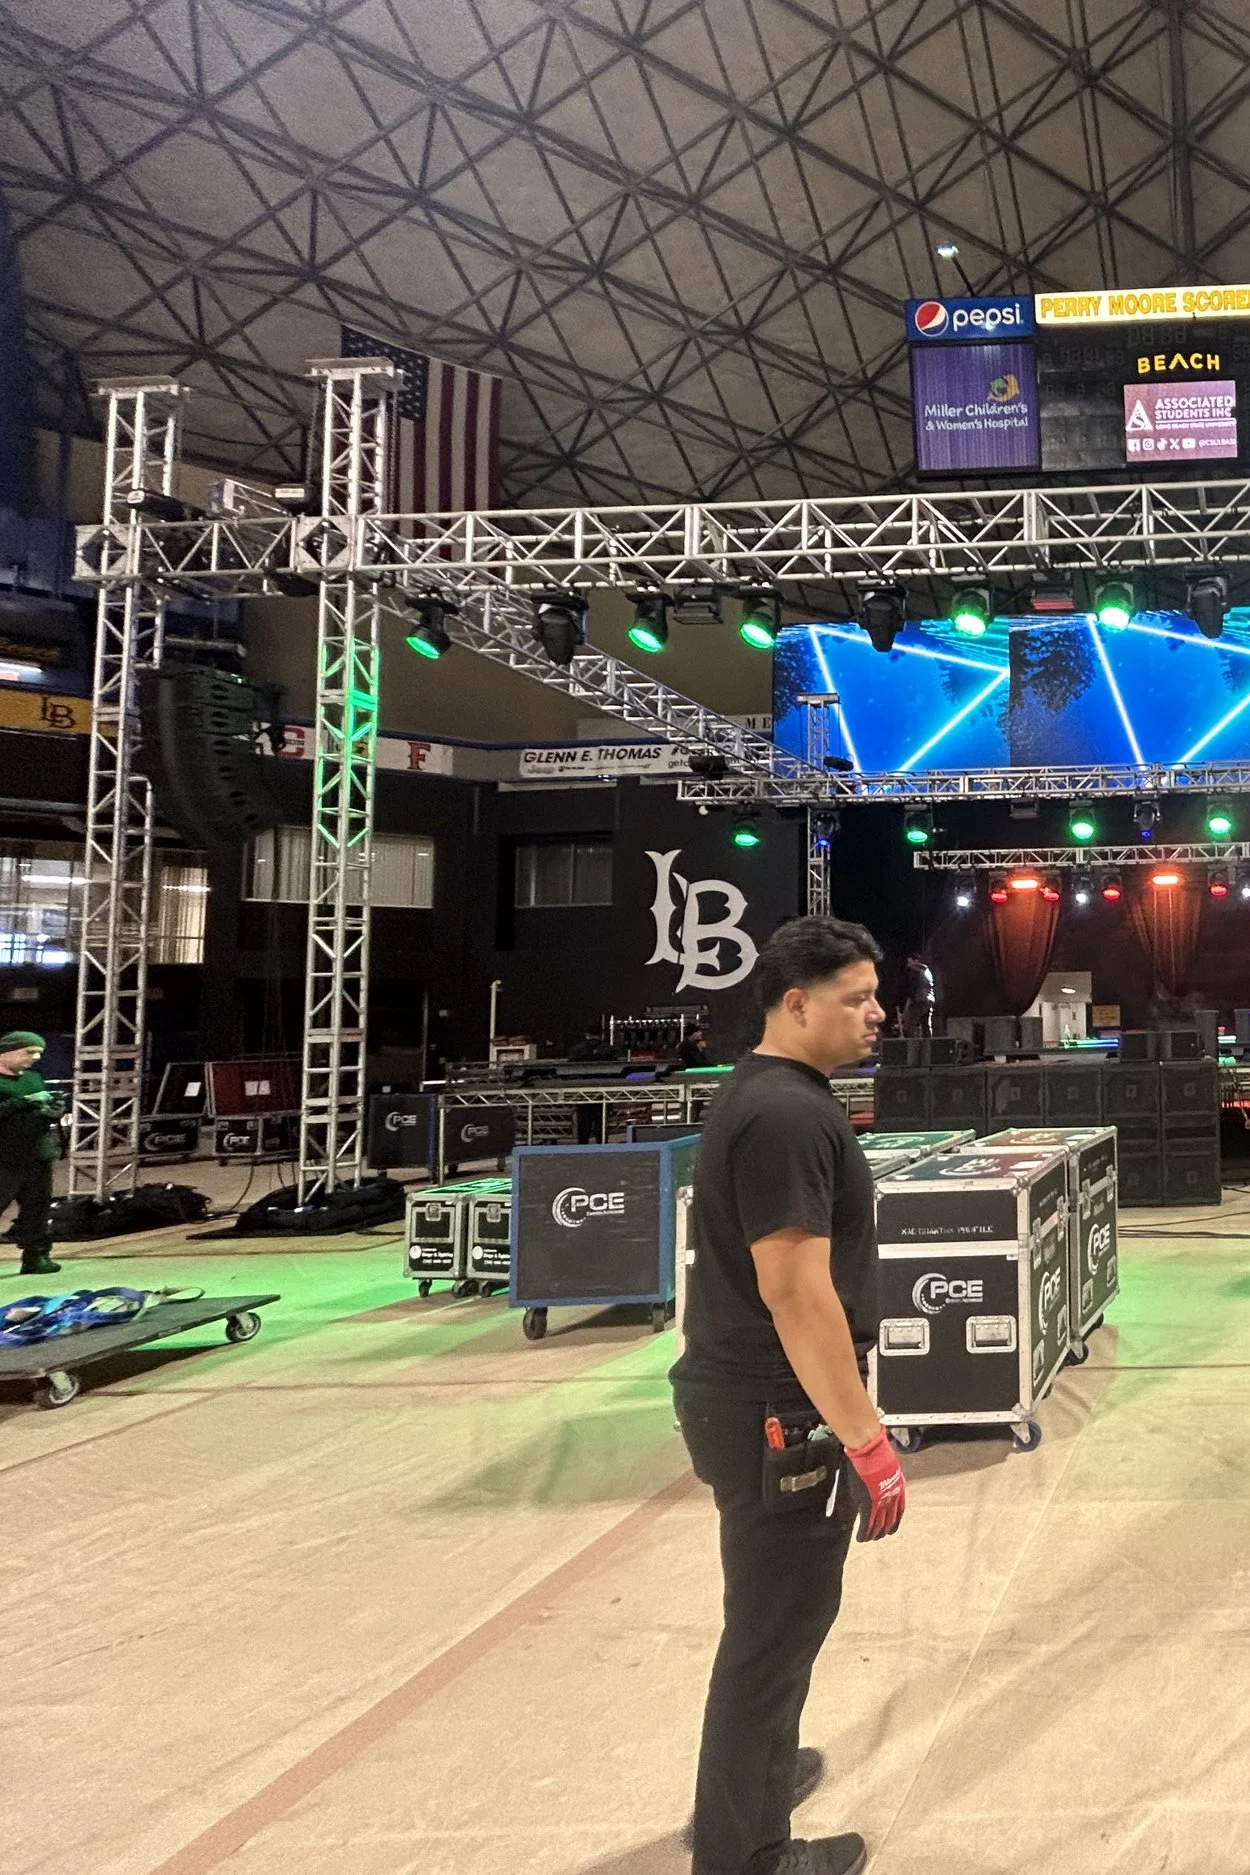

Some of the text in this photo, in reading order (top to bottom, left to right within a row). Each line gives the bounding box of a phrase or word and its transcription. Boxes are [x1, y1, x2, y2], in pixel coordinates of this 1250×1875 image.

[1041, 296, 1101, 318] PERRY
[1109, 292, 1177, 315] MOORE
[953, 303, 1022, 332] pepsi
[1137, 353, 1220, 374] BEACH
[925, 402, 1028, 417] Miller Children's
[1155, 396, 1235, 410] ASSOCIATED
[1155, 407, 1232, 419] STUDENTS INC
[925, 416, 1029, 431] & Women's Hospital
[407, 741, 431, 771] F
[524, 751, 577, 764] GLENN
[581, 750, 593, 762] E.
[597, 747, 662, 760] THOMAS
[644, 849, 760, 994] LB
[570, 1192, 625, 1213] PCE
[1093, 1223, 1111, 1256] PCE
[930, 1279, 984, 1299] PCE
[1044, 1266, 1061, 1310] PCE
